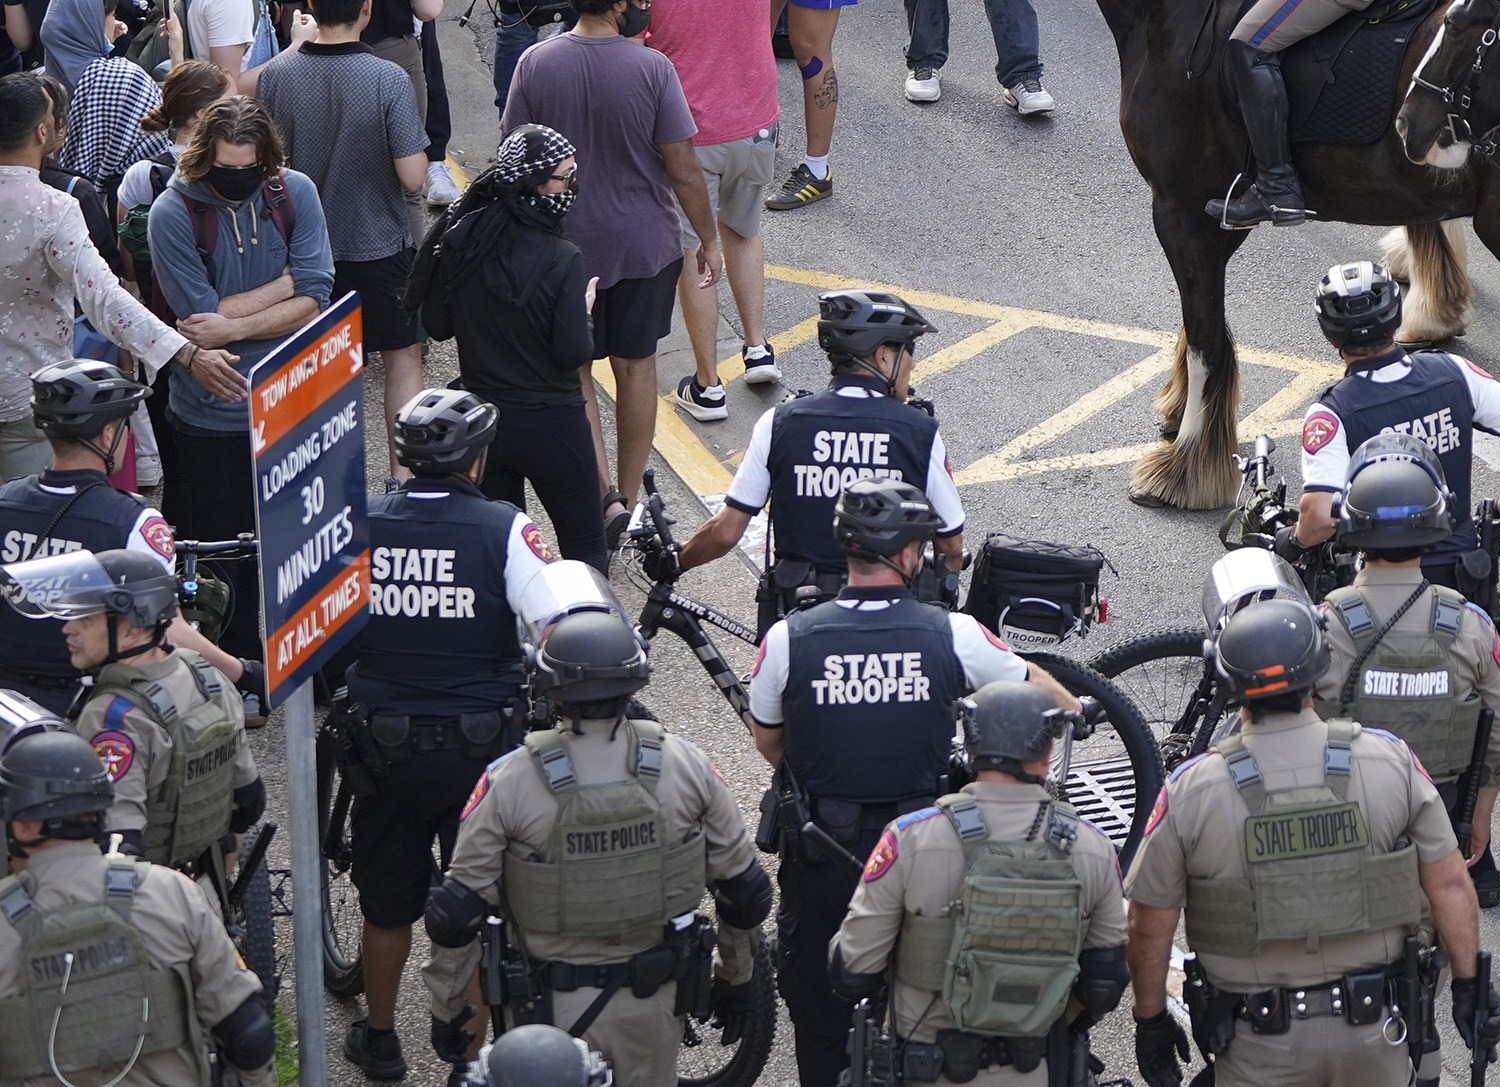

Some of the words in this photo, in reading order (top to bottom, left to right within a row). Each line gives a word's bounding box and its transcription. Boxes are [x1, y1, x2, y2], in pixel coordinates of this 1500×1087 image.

[260, 374, 288, 413] TOW
[288, 349, 319, 392] AWAY
[320, 324, 352, 367] ZONE
[262, 432, 320, 502] LOADING
[320, 400, 357, 452] ZONE
[812, 430, 891, 465] STATE
[793, 465, 904, 498] TROO
[300, 476, 325, 525] 30
[277, 506, 353, 605] MINUTES
[371, 546, 456, 583] STATE
[370, 583, 476, 618] ROOPER
[669, 592, 706, 616] STATE
[707, 611, 759, 644] TROOPER
[277, 630, 296, 672] AT
[294, 610, 321, 655] ALL
[320, 572, 361, 627] TIMES
[1006, 631, 1056, 644] TROOPER
[823, 651, 922, 681] STATE
[1364, 669, 1401, 696] STATE
[1401, 670, 1449, 697] TROOPER
[811, 676, 931, 705] TROOPER
[187, 753, 213, 781] STATE
[566, 831, 608, 854] STATE
[611, 821, 656, 850] POLICE
[1253, 818, 1297, 856] STATE
[1298, 809, 1360, 850] TROOPER
[31, 952, 78, 982] STAE
